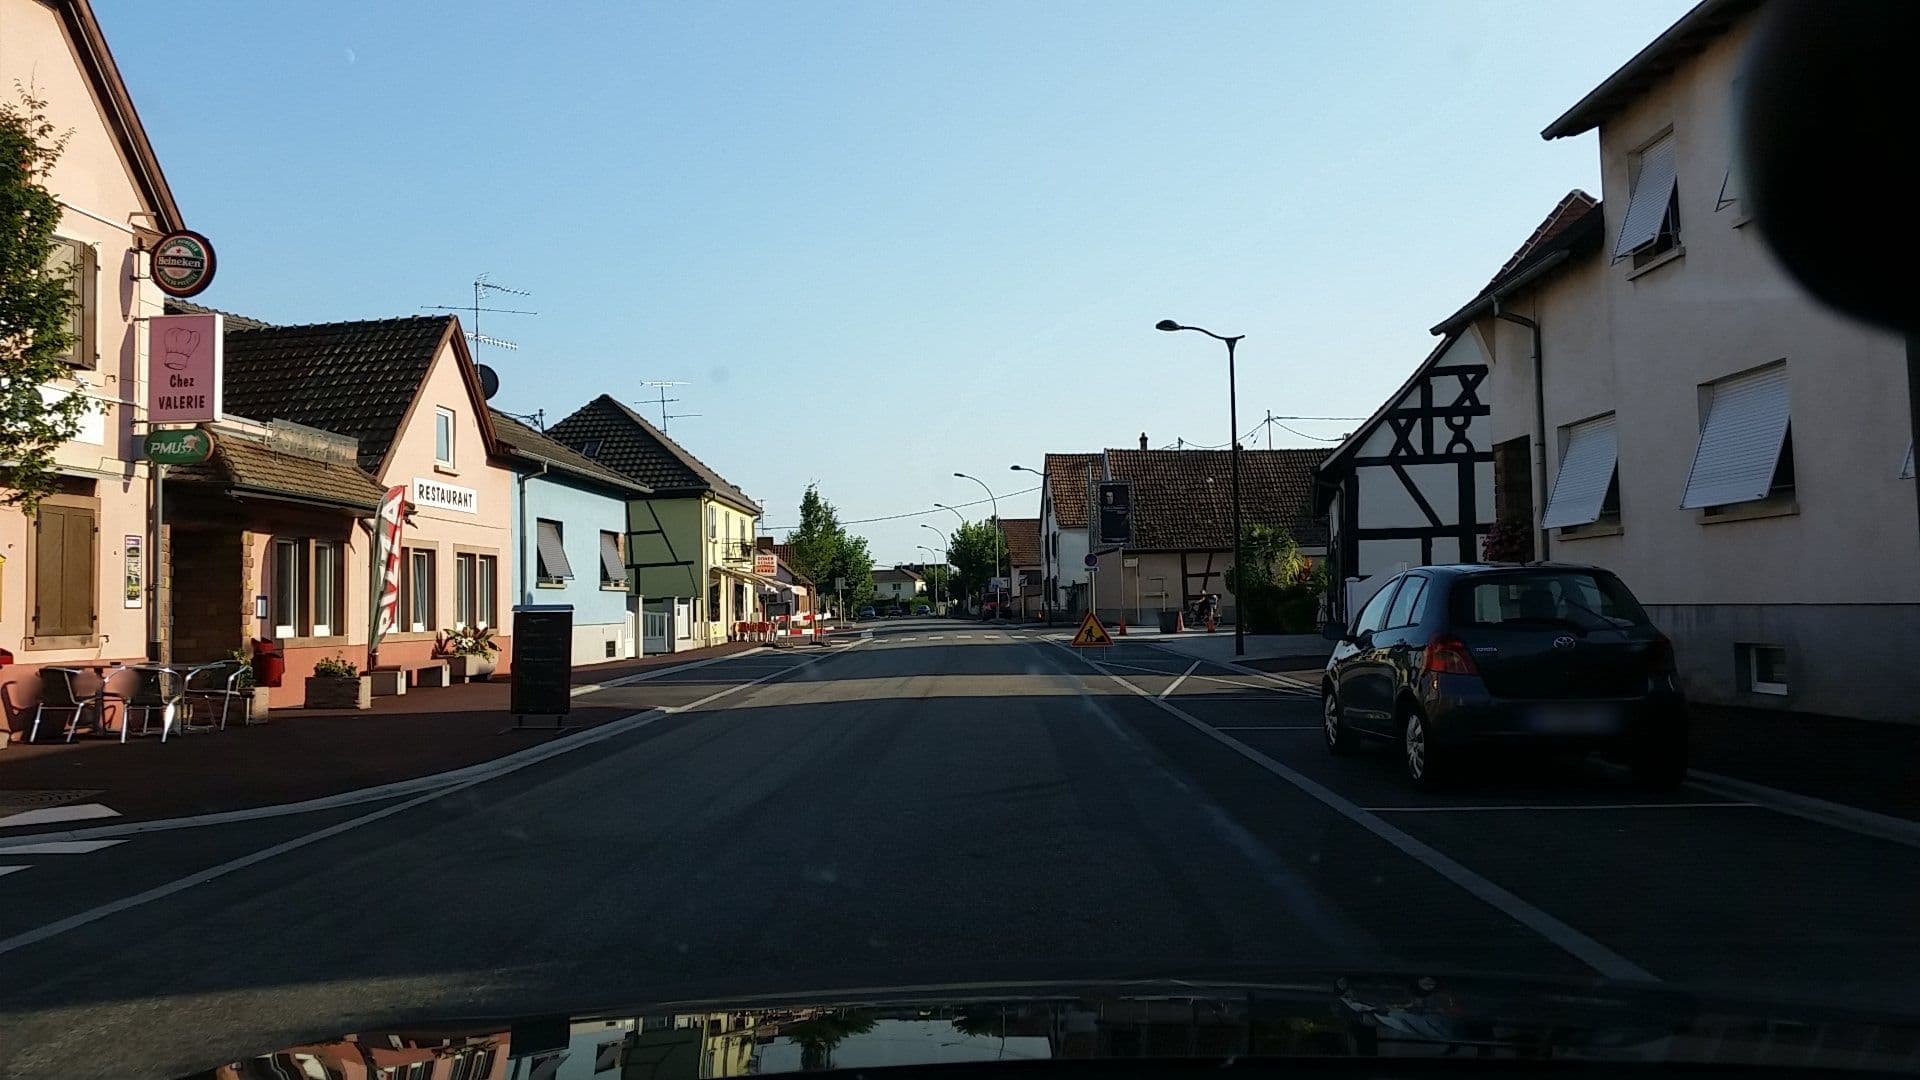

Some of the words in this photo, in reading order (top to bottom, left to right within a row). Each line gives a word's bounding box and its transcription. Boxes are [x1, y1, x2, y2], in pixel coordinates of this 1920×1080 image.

[158, 256, 201, 268] Heineken
[169, 373, 195, 388] Chez
[158, 395, 205, 410] VALERIE
[150, 442, 181, 454] PMU
[418, 483, 473, 508] RESTAURANT
